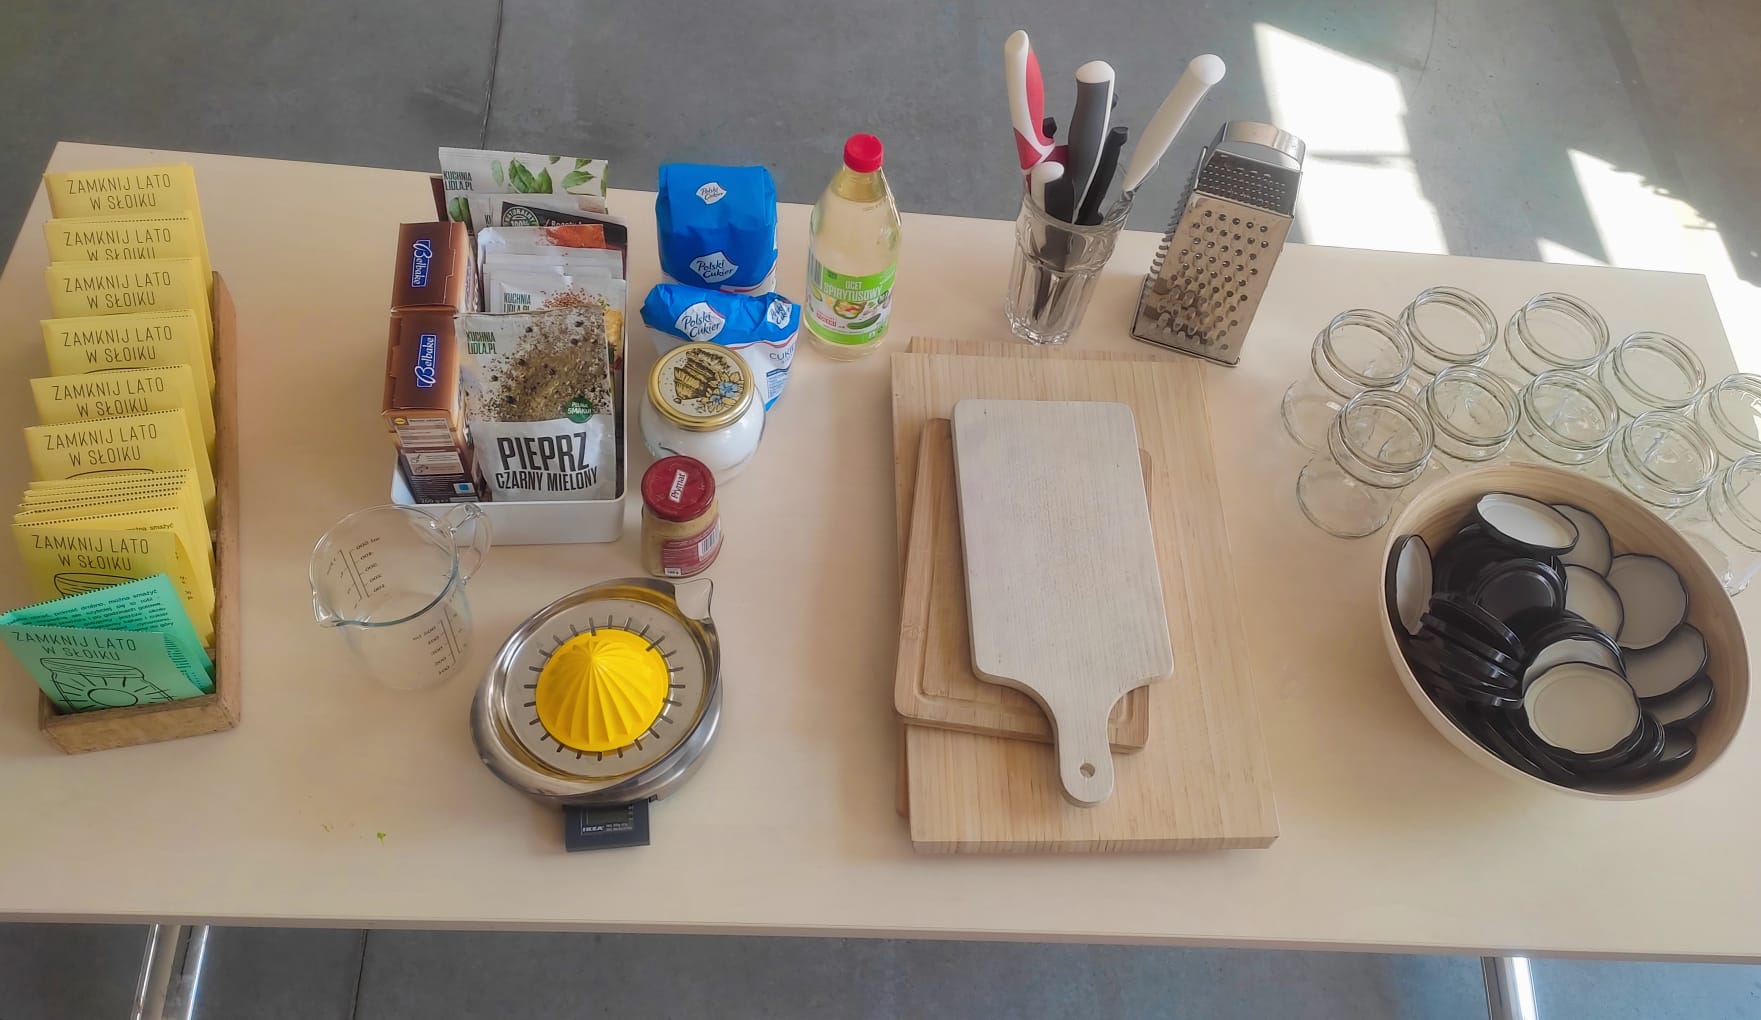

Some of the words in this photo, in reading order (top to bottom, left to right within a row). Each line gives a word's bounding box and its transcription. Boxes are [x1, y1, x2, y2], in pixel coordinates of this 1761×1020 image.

[67, 177, 130, 195] ZAMKNIJ
[136, 173, 171, 189] LATO
[443, 170, 473, 182] KUCHNIA
[445, 181, 474, 191] LIDLA.PL
[90, 197, 102, 211] W
[107, 193, 157, 210] SŁOIKU
[63, 229, 130, 247] ZAMKNIJ
[136, 227, 171, 244] LATO
[87, 248, 99, 261] W
[412, 243, 433, 285] Belbake
[696, 259, 725, 271] Polski
[703, 269, 734, 278] Cukier
[63, 276, 130, 293] ZAMKNIJ
[135, 271, 171, 288] LATO
[845, 280, 863, 290] OCET
[86, 295, 99, 310] W
[105, 291, 156, 309] SŁOIKU
[503, 292, 531, 305] KUCHNIA
[682, 311, 712, 329] Polski
[63, 329, 130, 348] ZAMKNIJ
[136, 325, 173, 342] LATO
[466, 331, 496, 343] KUCHNIA
[689, 323, 720, 338] Cukier
[85, 350, 98, 364] W
[105, 345, 157, 363] SŁOIKU
[467, 342, 497, 355] LIDLA.PL
[415, 337, 436, 384] Belbake
[52, 383, 121, 401] ZAMKNIJ
[127, 376, 164, 394] LATO
[76, 403, 90, 418] W
[95, 398, 149, 417] SŁOIKU
[43, 433, 114, 451] ZAMKNIJ
[119, 424, 158, 441] LATO
[68, 452, 82, 467] W
[88, 446, 142, 466] SŁOIKU
[496, 431, 590, 473] PIEPRZ
[495, 470, 543, 492] CZARNY
[547, 466, 598, 492] MIELONY
[31, 534, 104, 553] ZAMKNIJ
[109, 538, 150, 555] LATO
[57, 553, 72, 567] W
[77, 554, 132, 572] SŁOIKU
[11, 631, 90, 648] ZAMKNIJ
[95, 635, 138, 652] LATO
[41, 646, 57, 655] W
[62, 647, 121, 661] SŁOIKU
[582, 825, 604, 833] IKEA
